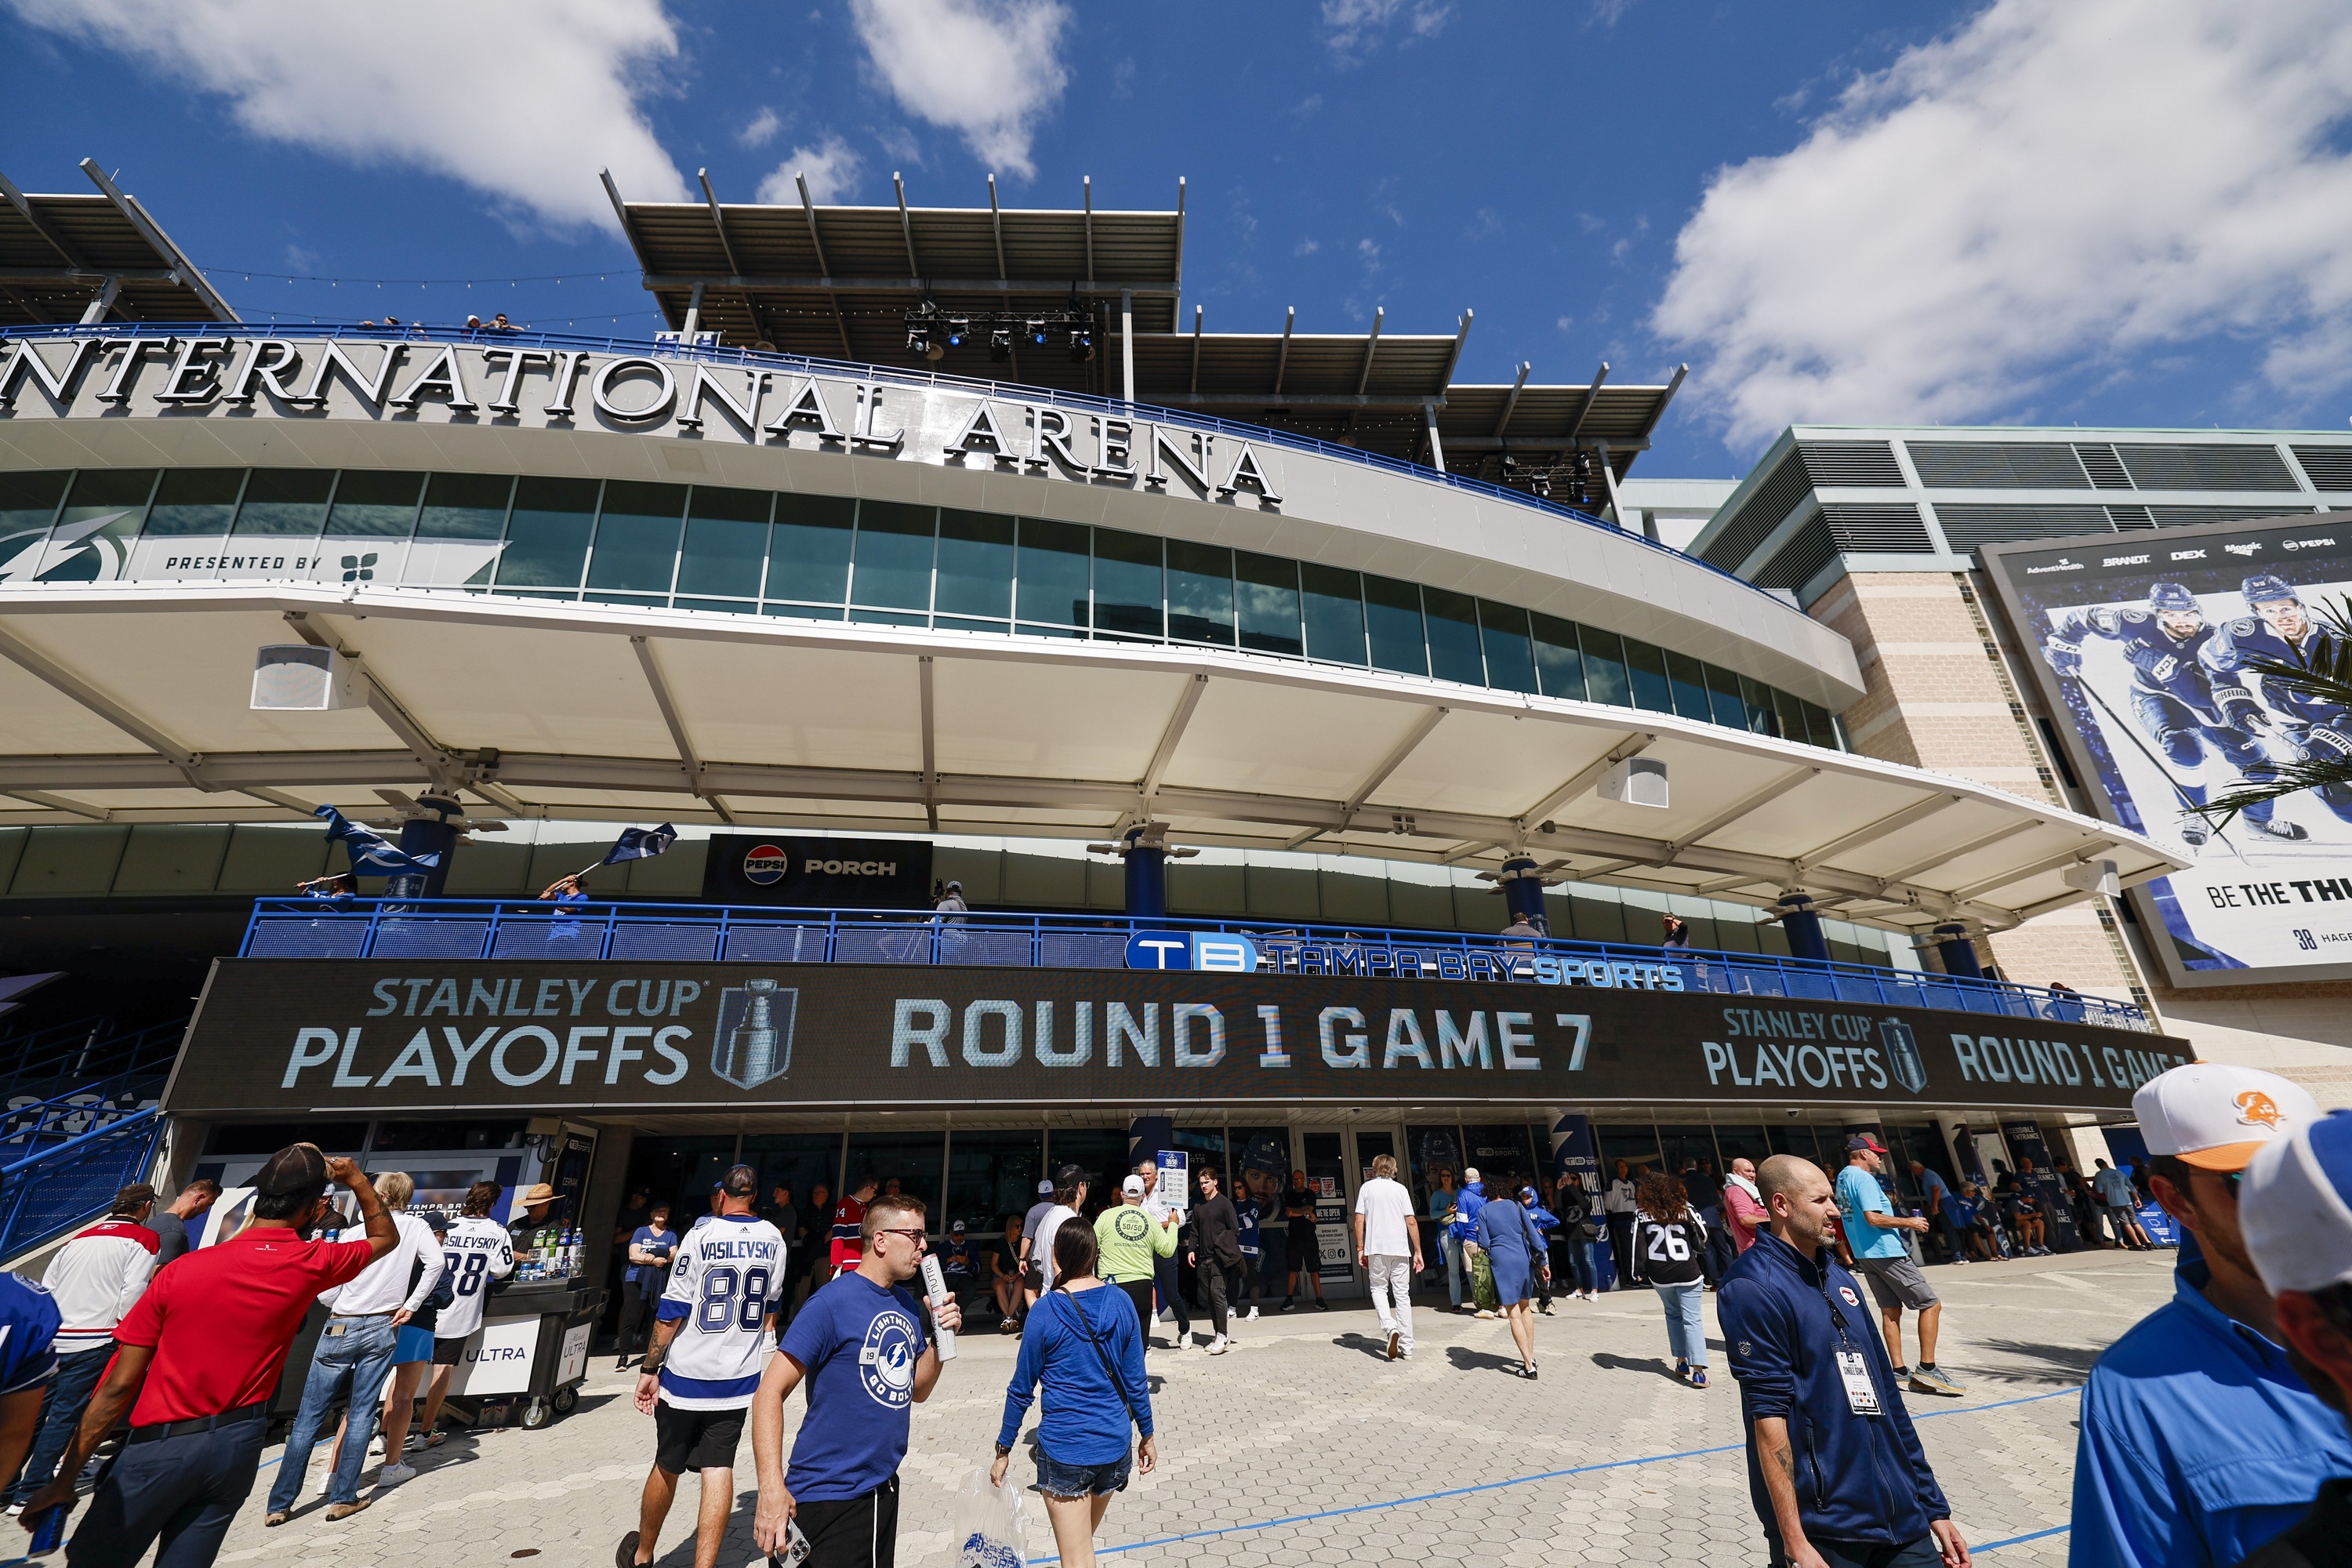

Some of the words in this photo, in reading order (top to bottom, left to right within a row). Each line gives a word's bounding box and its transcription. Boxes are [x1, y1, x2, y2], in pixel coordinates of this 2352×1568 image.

[0, 336, 904, 451] NTERNATIONAL
[943, 397, 1283, 504] ARENA
[2224, 542, 2263, 553] Mosaic
[2299, 539, 2336, 548] PEPSI
[165, 557, 285, 570] PRESENTED
[295, 557, 321, 570] BY
[2102, 554, 2151, 567] BRANDT
[2170, 550, 2207, 561] DEX
[2027, 563, 2085, 574] AdventHealth
[746, 859, 785, 870] PEPSI
[804, 859, 897, 877] PORCH
[2207, 886, 2241, 908] BE
[2239, 883, 2291, 906] THE
[2293, 929, 2318, 950] 38
[1137, 939, 1248, 972] TB
[1263, 944, 1425, 980] TAMPA
[1437, 951, 1520, 983] BAY
[1531, 956, 1686, 992] SPORTS
[366, 978, 598, 1018] STANLEY
[1722, 1007, 1828, 1040] STANLEY
[890, 998, 1226, 1068] ROUND
[1257, 1004, 1291, 1069] 1
[1318, 1006, 1542, 1071] GAME
[1555, 1014, 1593, 1072] 7
[281, 1025, 693, 1089] PLAYOFFS
[1701, 1040, 1889, 1091] PLAYOFFS
[1950, 1033, 2082, 1087] ROUND
[2080, 1044, 2106, 1088] 1
[1261, 1144, 1271, 1152] 86
[835, 1207, 845, 1218] 14
[1250, 1207, 1258, 1218] 43
[1329, 1208, 1341, 1217] OPEN
[1122, 1223, 1142, 1232] 50/50
[442, 1236, 501, 1250] ASILEVSKIY
[700, 1240, 778, 1261] VASILEVSKIY
[1646, 1224, 1691, 1262] 26
[695, 1265, 770, 1334] 88
[871, 1315, 918, 1345] LIGHTNING
[466, 1347, 526, 1363] ULTRA
[564, 1341, 586, 1358] ULTRA
[866, 1352, 875, 1360] 19
[869, 1374, 887, 1396] GO
[888, 1385, 913, 1402] BOLT
